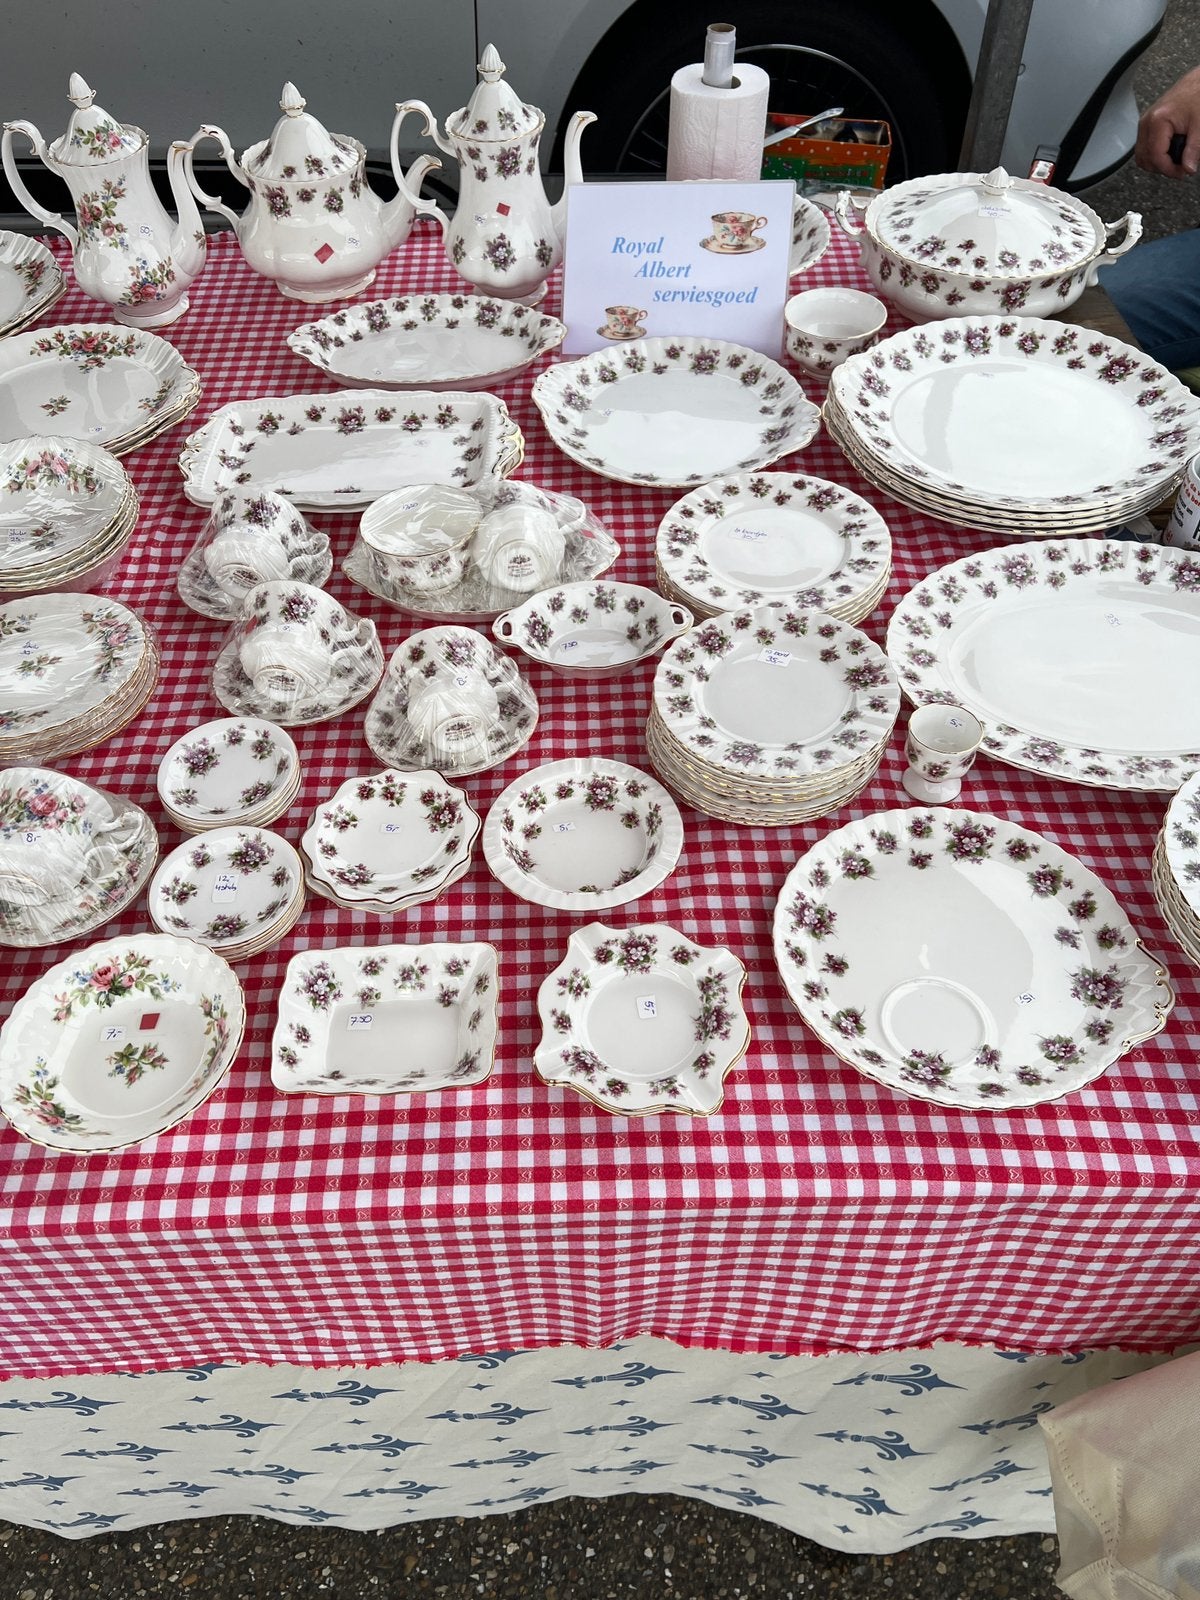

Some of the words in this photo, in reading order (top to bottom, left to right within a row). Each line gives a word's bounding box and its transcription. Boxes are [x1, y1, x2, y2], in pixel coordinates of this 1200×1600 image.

[611, 236, 665, 258] Royal
[634, 261, 692, 278] Albert
[652, 285, 759, 308] serviesgoed
[385, 824, 400, 832] 5,-
[26, 832, 41, 843] 8,-
[106, 1028, 123, 1041] 7,-
